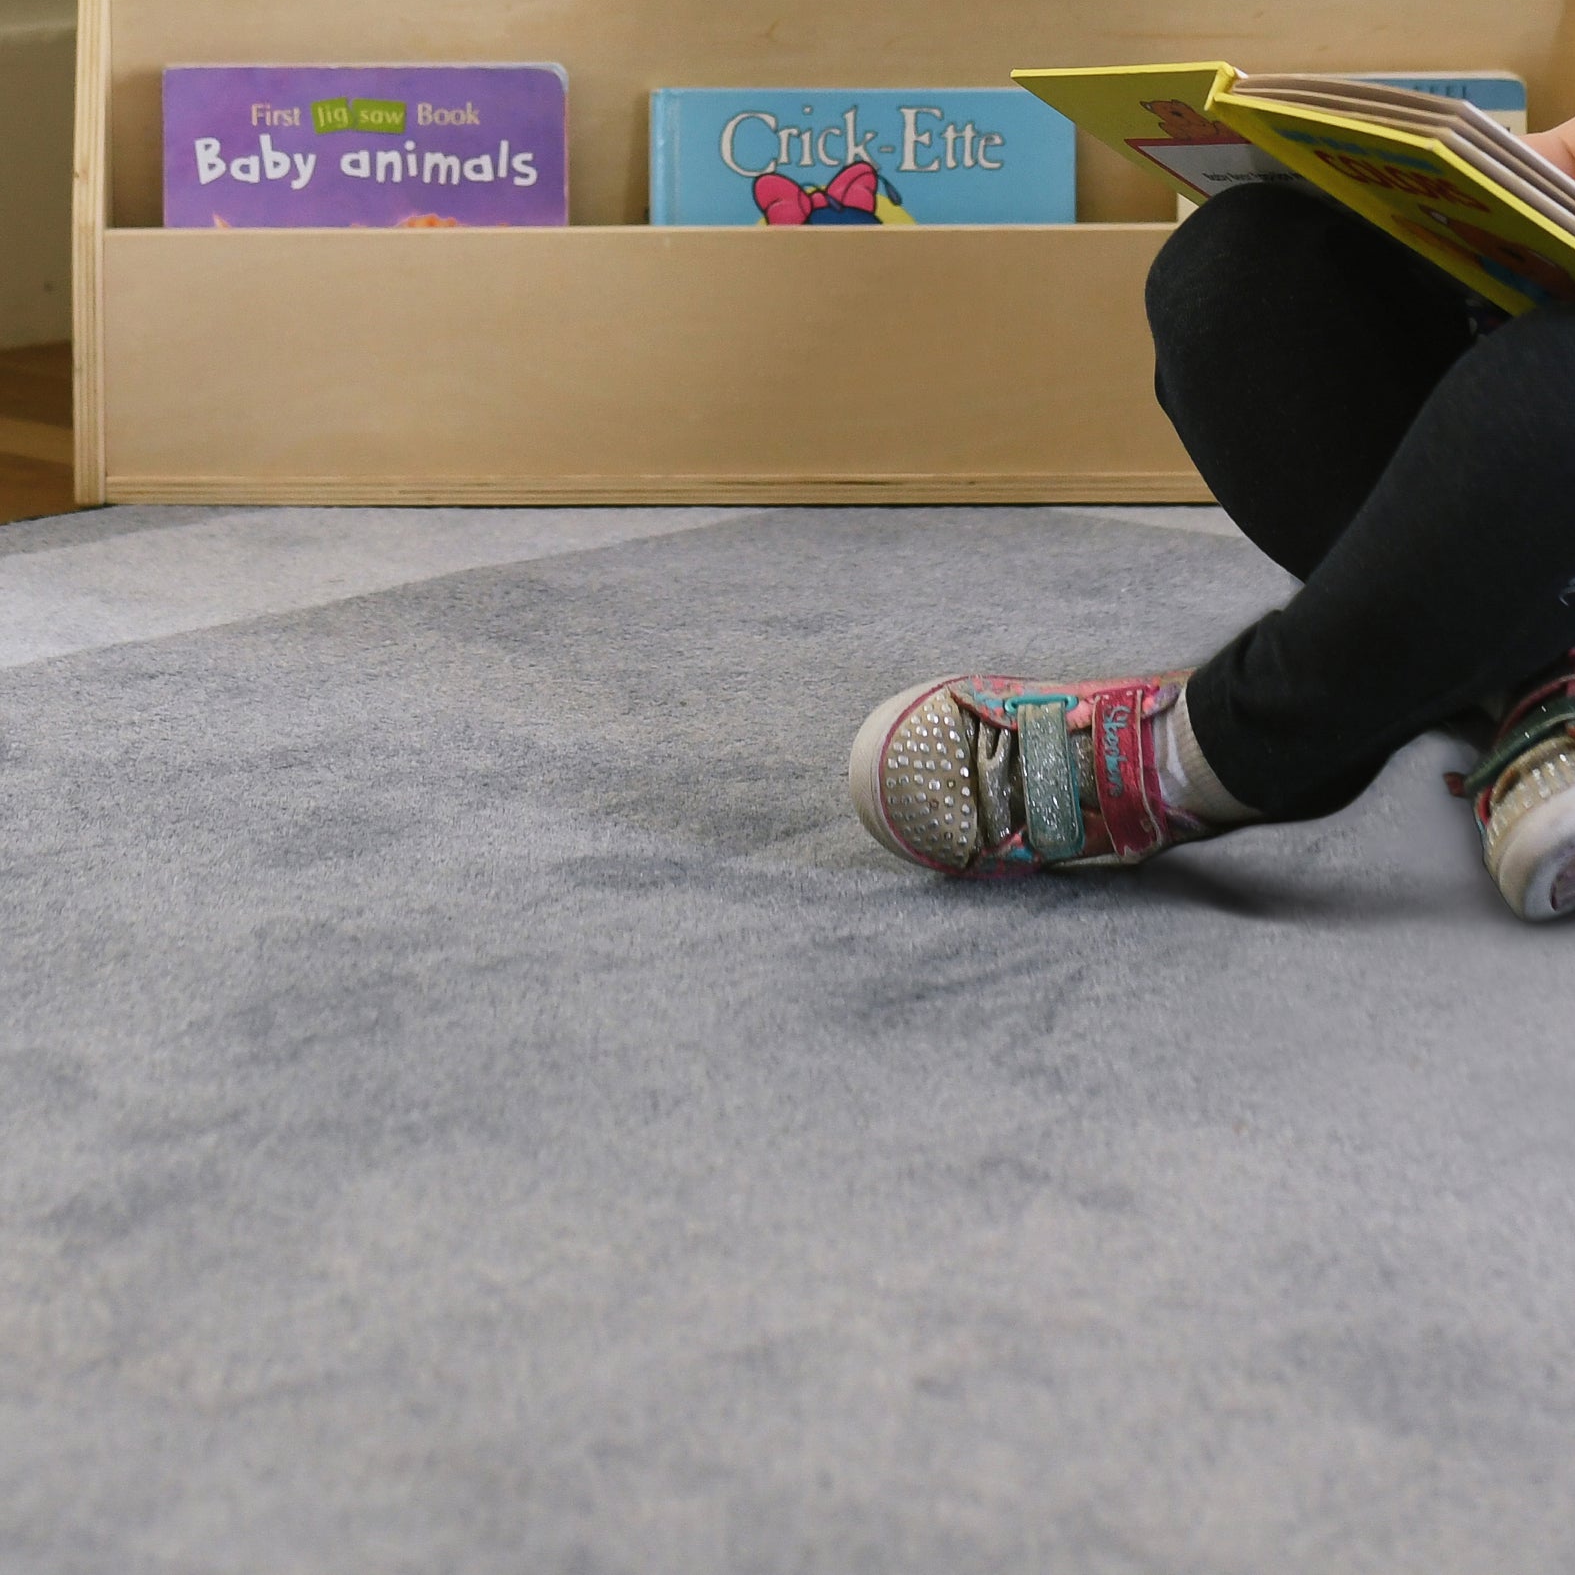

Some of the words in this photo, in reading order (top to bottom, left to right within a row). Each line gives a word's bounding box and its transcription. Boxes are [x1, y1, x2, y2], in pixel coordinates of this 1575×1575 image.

[251, 102, 300, 127] First
[360, 108, 404, 125] saw
[417, 101, 481, 126] Book
[720, 105, 1005, 178] Crick-Ette
[194, 133, 317, 190] Baby
[340, 139, 538, 187] animals
